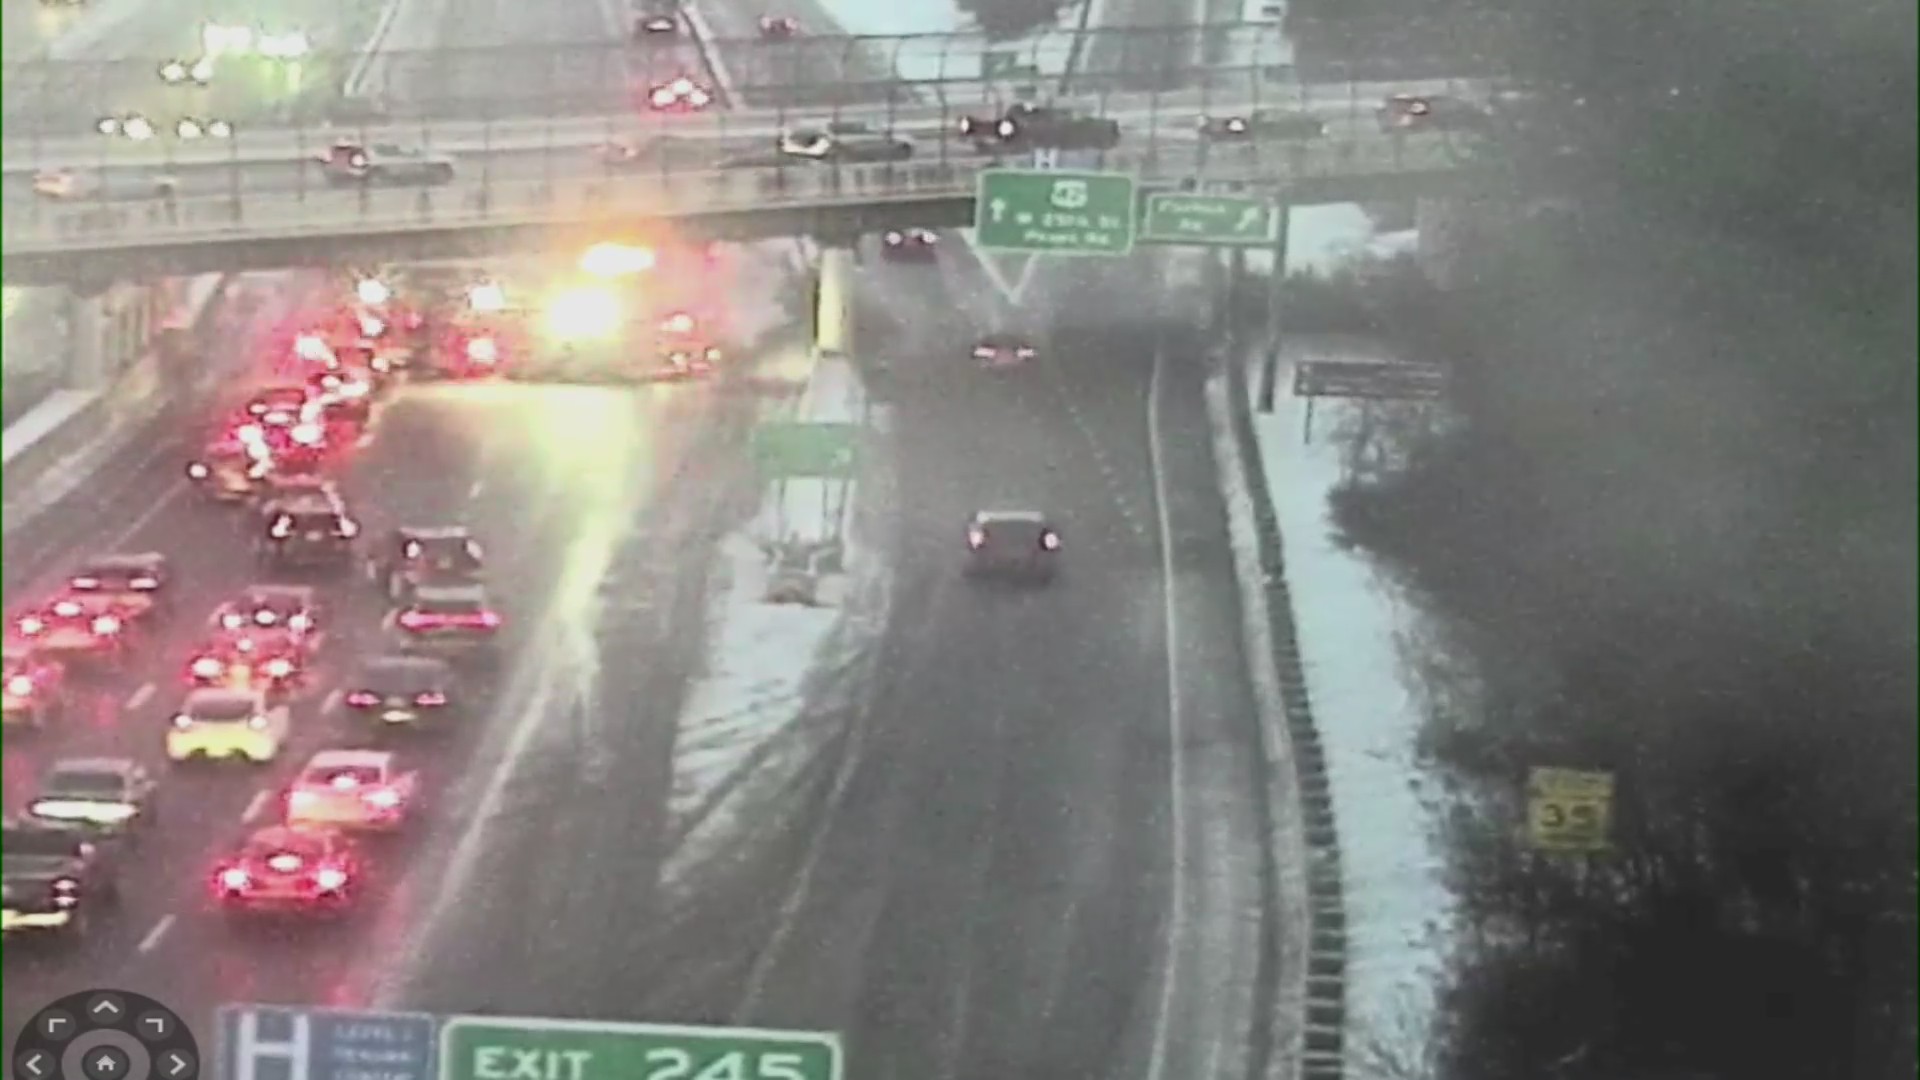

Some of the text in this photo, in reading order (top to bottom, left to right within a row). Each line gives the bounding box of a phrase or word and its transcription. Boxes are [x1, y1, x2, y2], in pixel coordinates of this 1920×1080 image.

[1541, 803, 1599, 830] 35
[472, 1045, 805, 1080] EXIT 245
